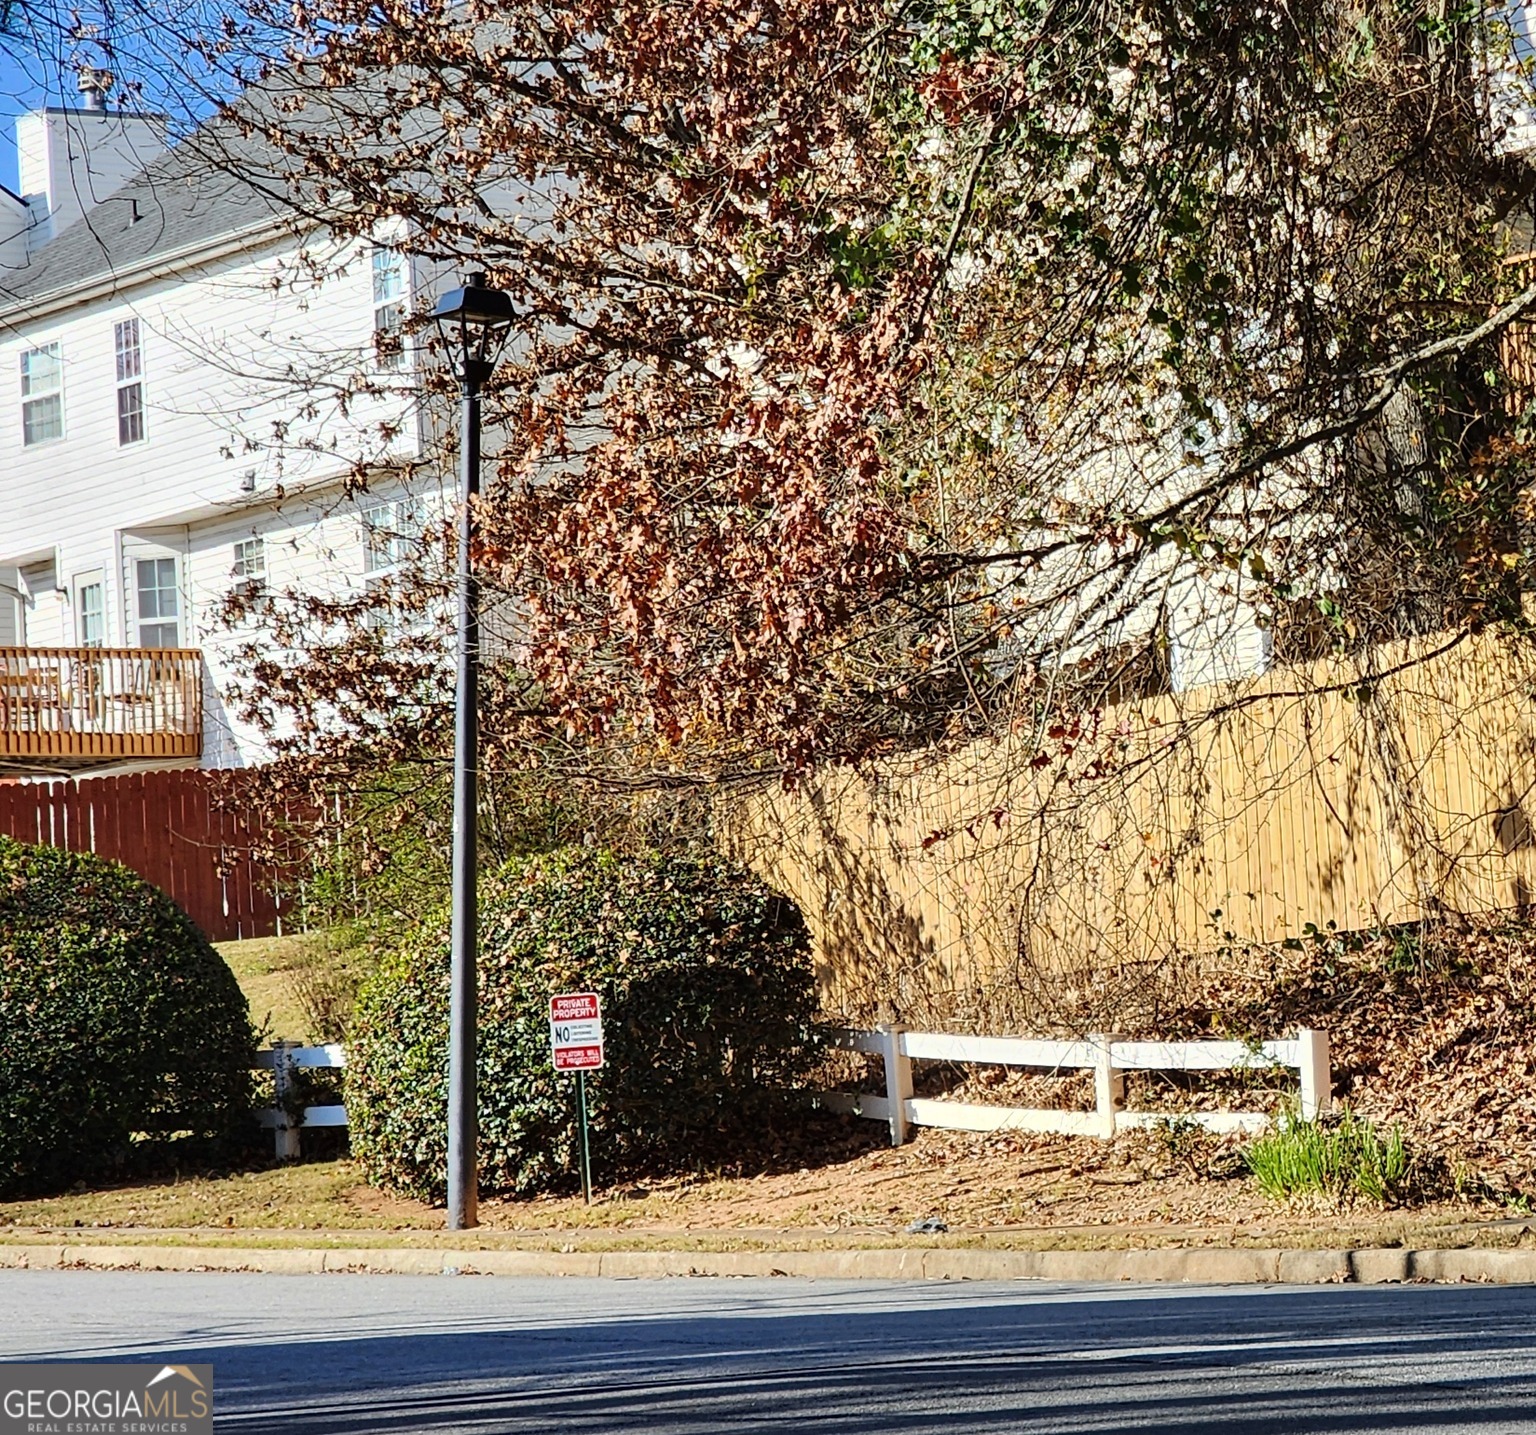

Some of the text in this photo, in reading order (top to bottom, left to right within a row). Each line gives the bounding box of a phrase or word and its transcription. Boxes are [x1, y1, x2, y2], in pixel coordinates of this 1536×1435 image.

[556, 998, 591, 1009] PRIVATE
[553, 1007, 596, 1019] PROPERTY
[555, 1026, 570, 1043] NO
